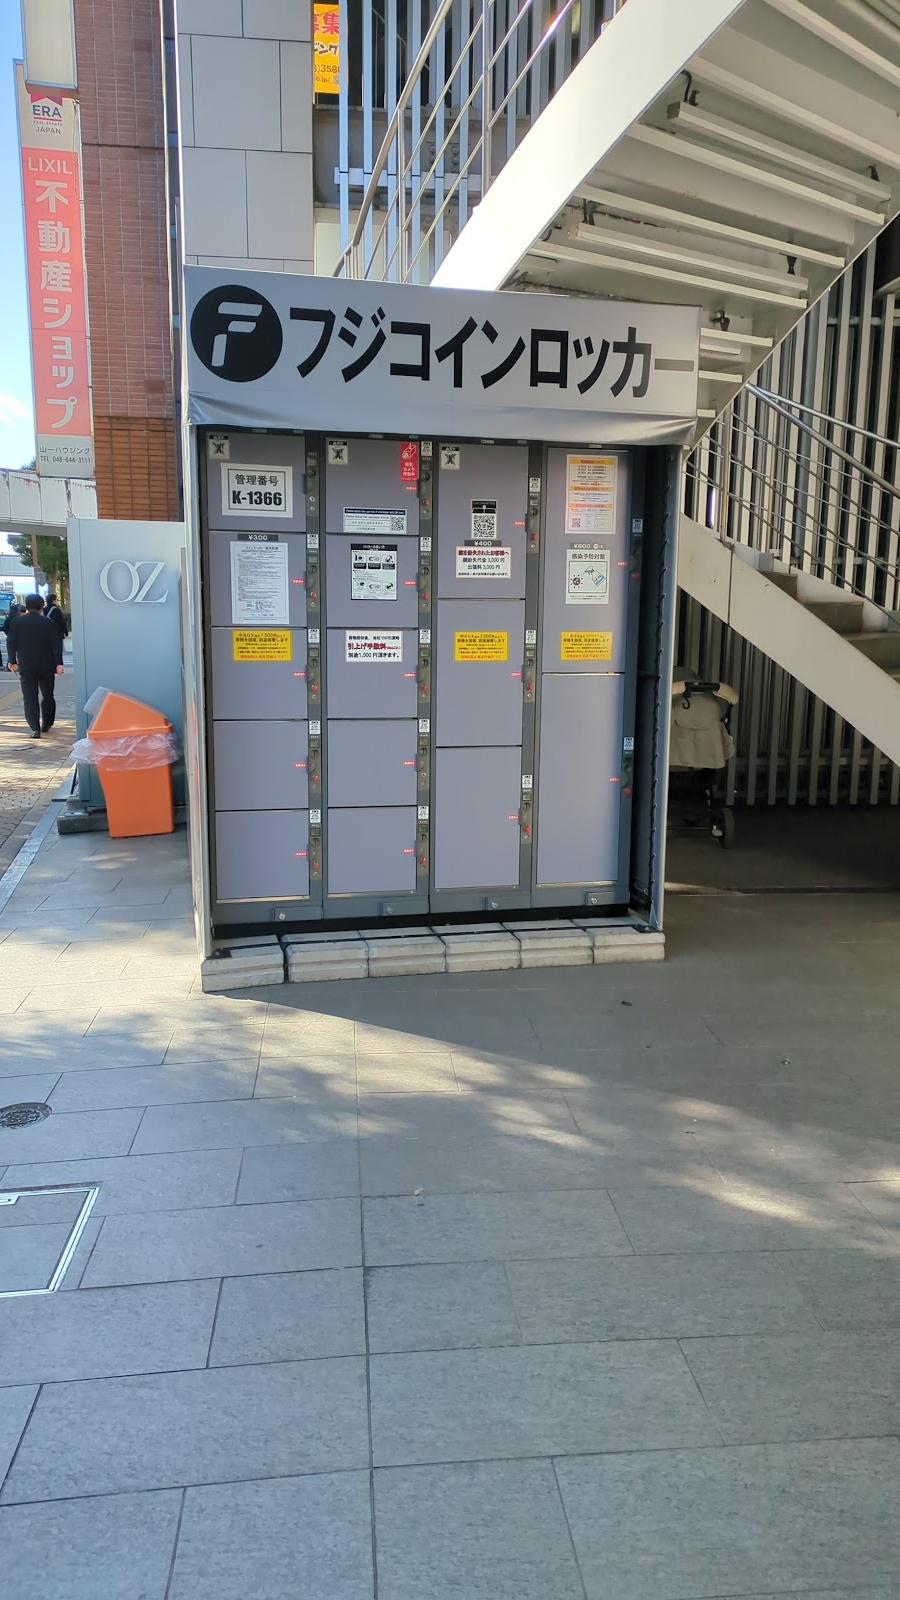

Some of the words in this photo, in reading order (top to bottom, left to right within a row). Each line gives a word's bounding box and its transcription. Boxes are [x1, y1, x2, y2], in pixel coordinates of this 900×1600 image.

[32, 104, 62, 118] ERA
[36, 126, 61, 134] JAPAN
[28, 156, 73, 175] LIXIL
[35, 179, 78, 429] 不動産ショップ
[289, 306, 695, 398] フジコインロッカー
[234, 473, 279, 486] 管理番号
[232, 490, 283, 506] K-1366
[99, 560, 169, 603] OZ
